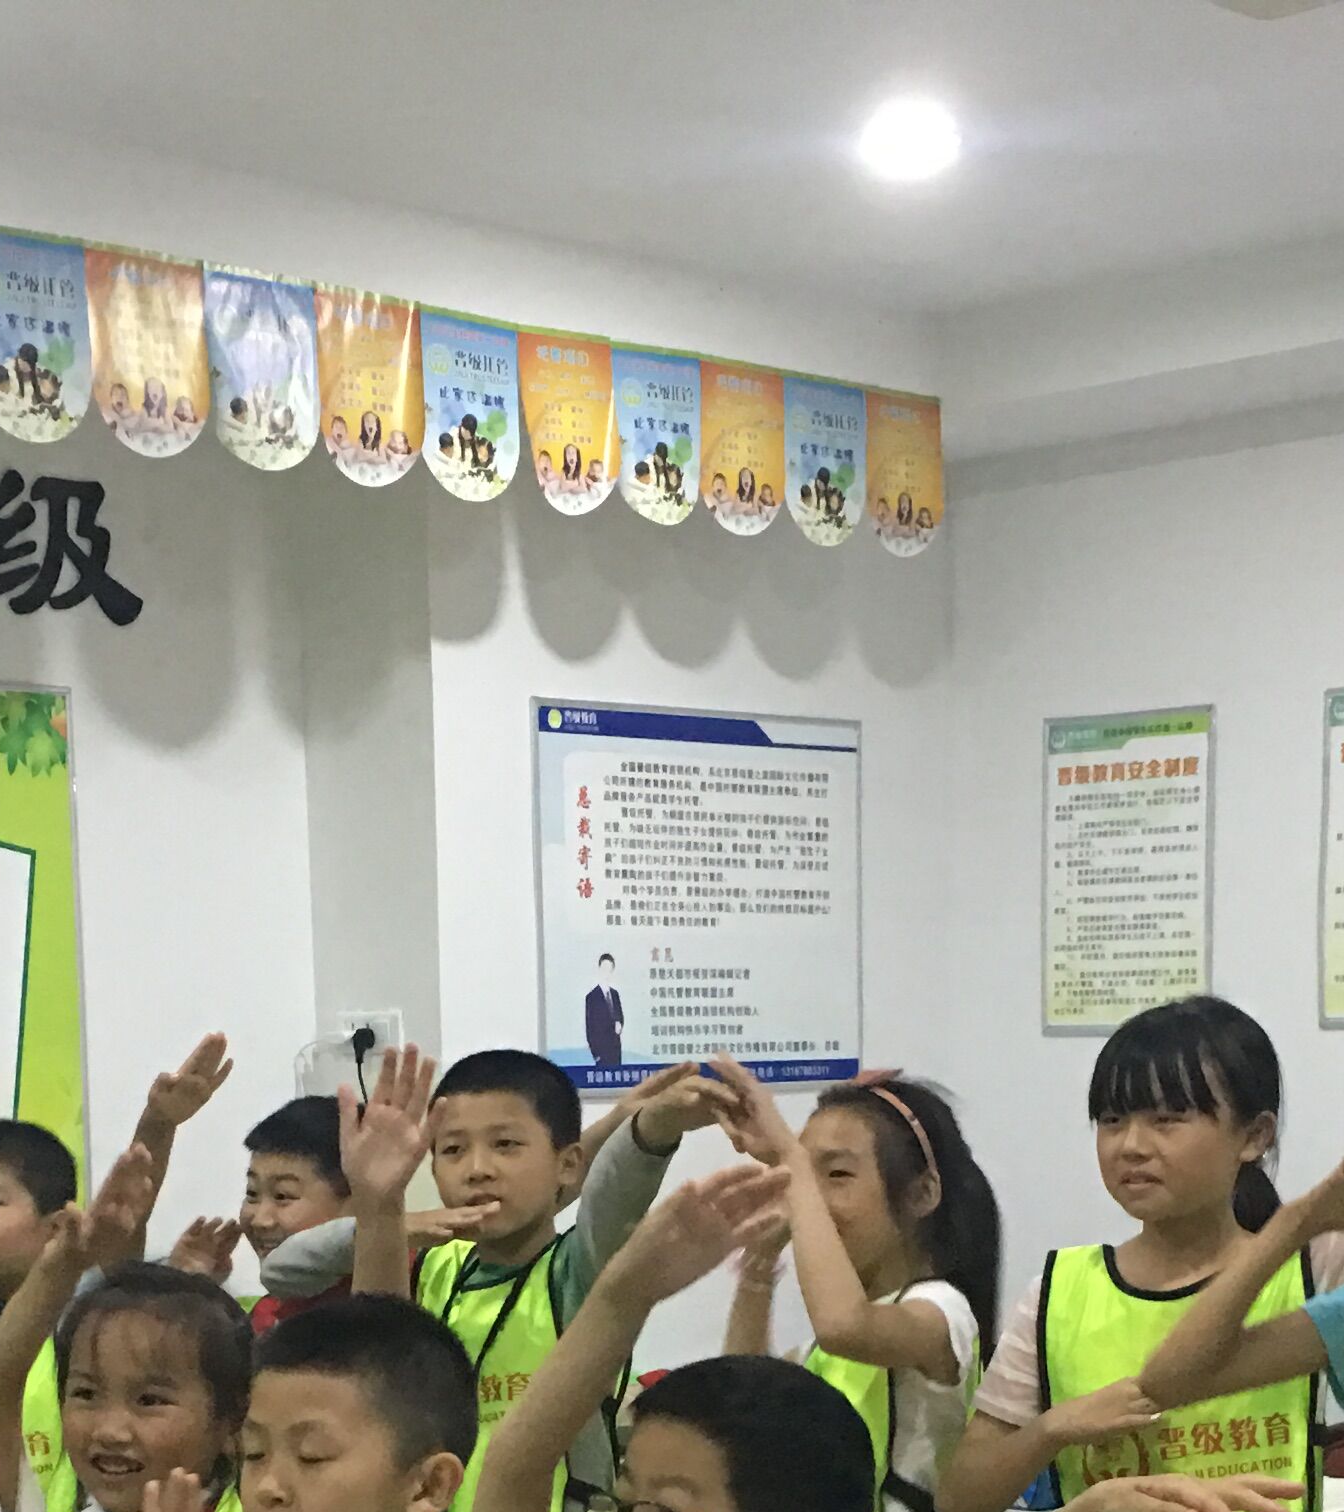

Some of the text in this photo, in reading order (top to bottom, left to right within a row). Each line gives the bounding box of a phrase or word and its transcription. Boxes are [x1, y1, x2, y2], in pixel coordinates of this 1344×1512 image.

[1158, 1411, 1291, 1461] 晋级教育
[1207, 1455, 1293, 1480] EDUCATION
